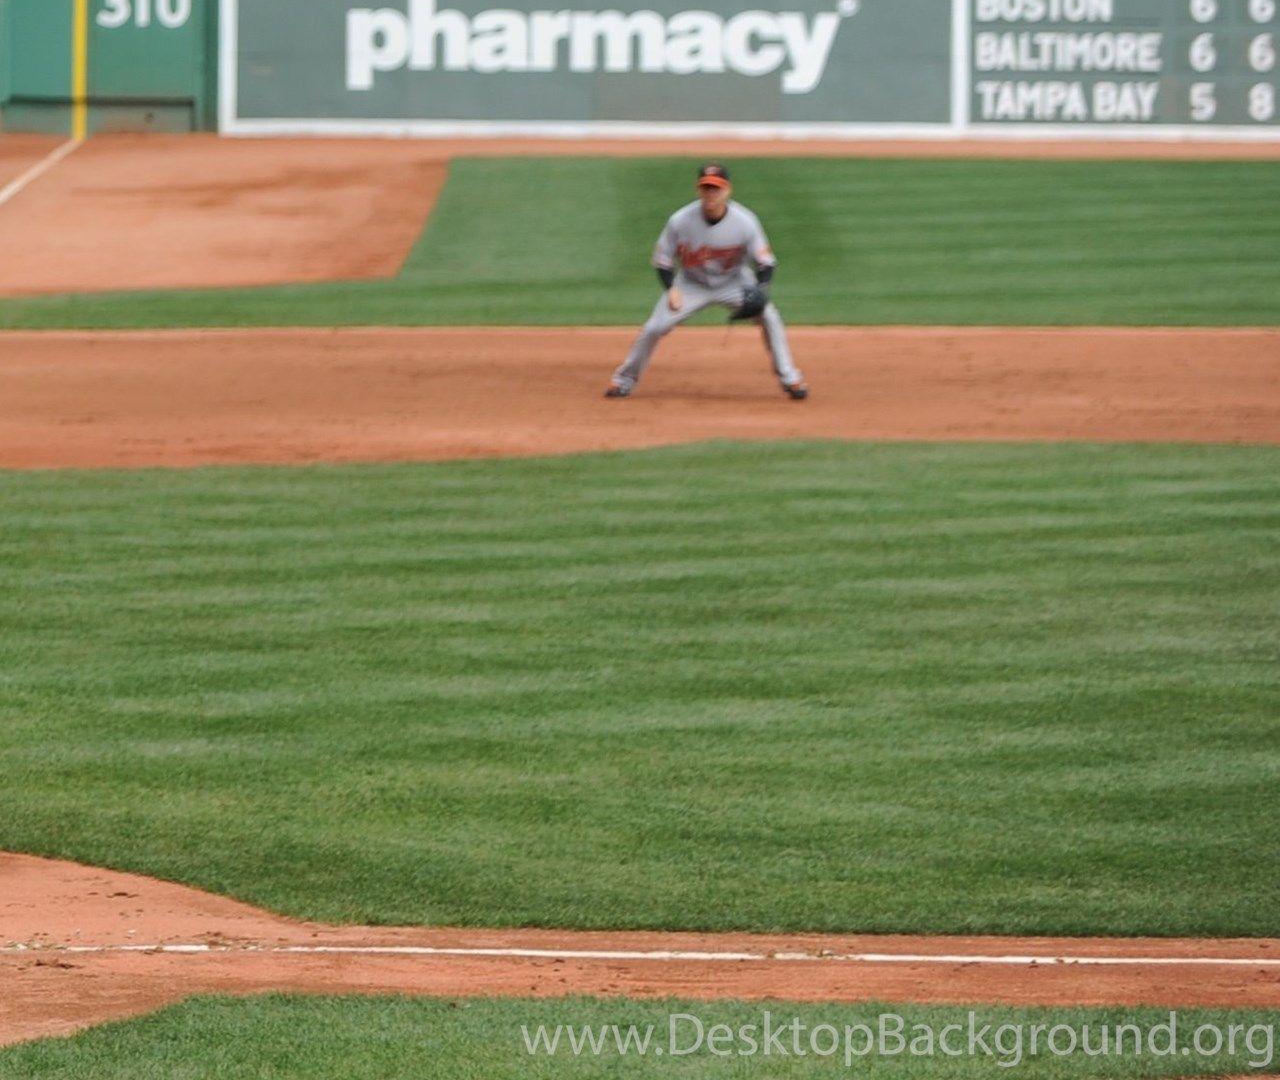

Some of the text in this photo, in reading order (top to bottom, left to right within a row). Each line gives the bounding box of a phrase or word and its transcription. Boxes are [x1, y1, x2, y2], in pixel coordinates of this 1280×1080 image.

[976, 32, 1276, 72] BALTIMORE 6 6
[976, 81, 1275, 121] TAMPA BAY 5 8
